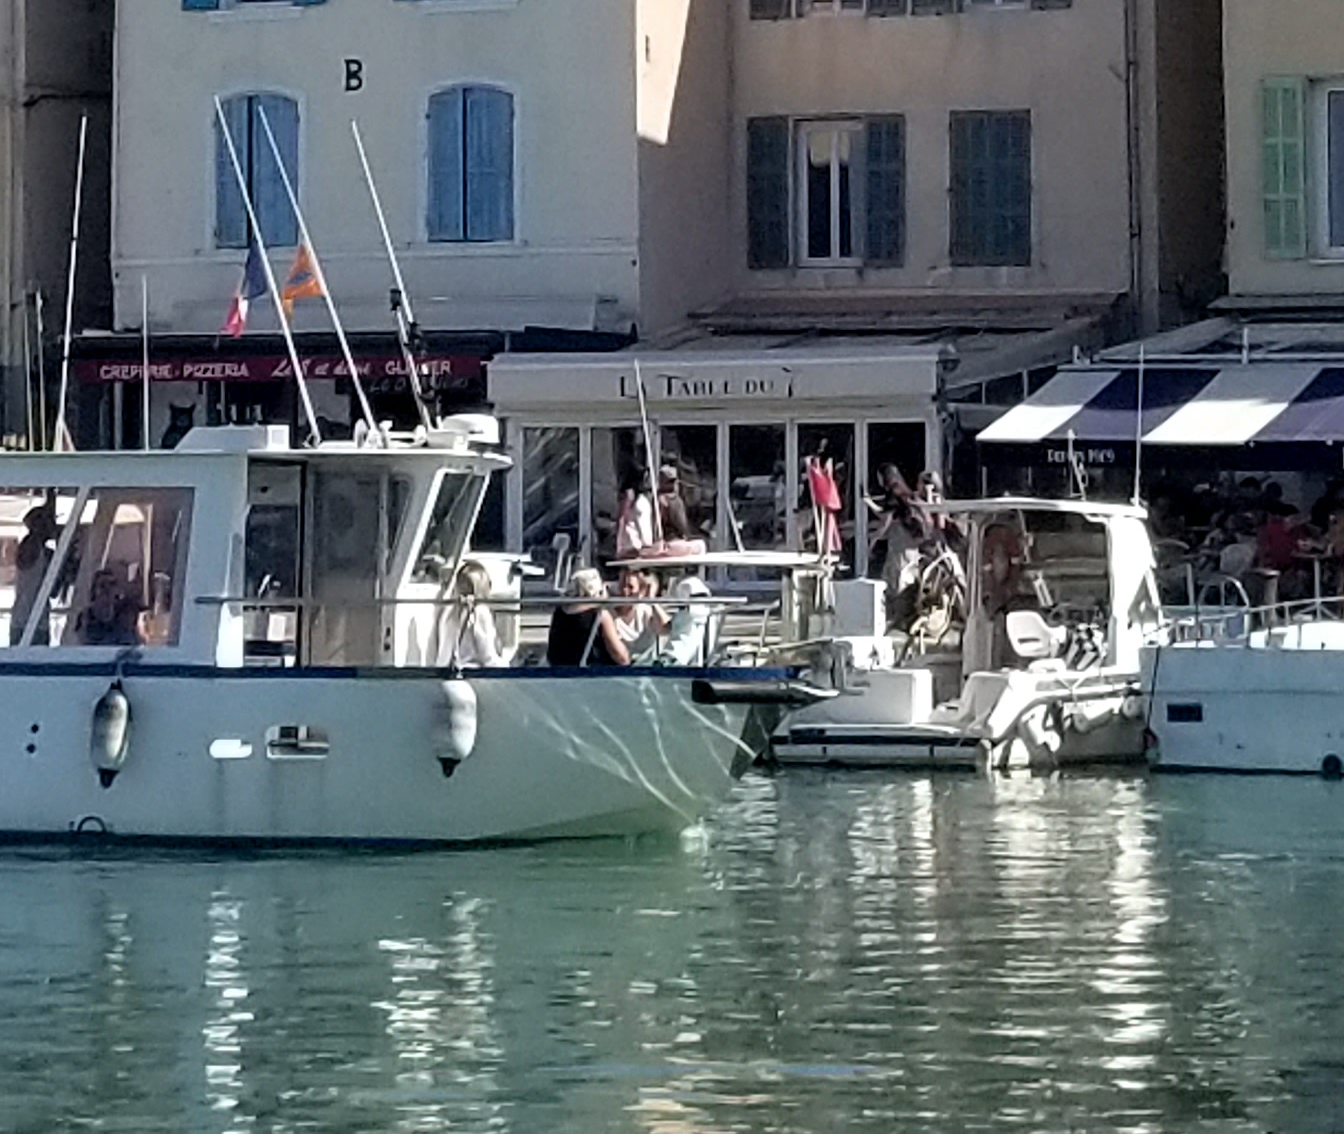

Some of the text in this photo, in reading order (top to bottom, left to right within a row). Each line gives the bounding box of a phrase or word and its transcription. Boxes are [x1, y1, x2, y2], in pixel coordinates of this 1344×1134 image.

[344, 58, 363, 92] B
[182, 362, 250, 379] PIZZERIA
[385, 359, 452, 377] GLAER
